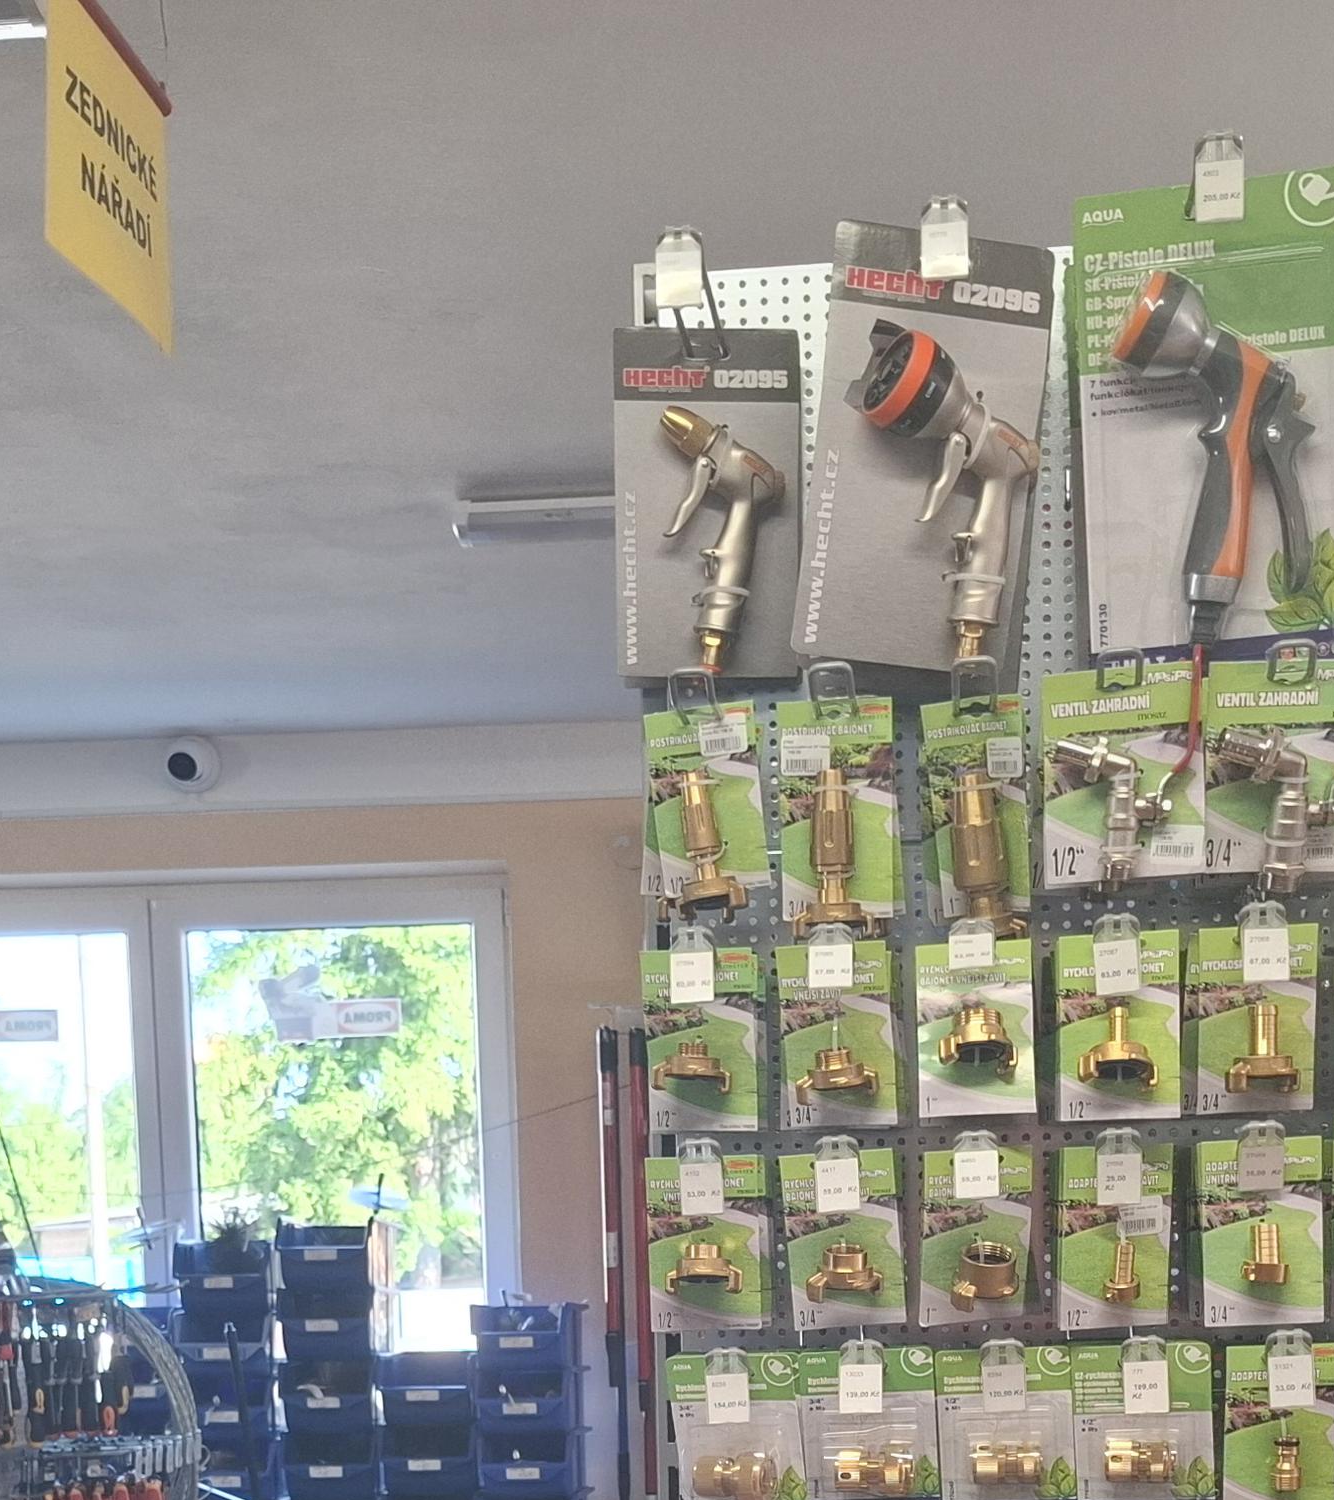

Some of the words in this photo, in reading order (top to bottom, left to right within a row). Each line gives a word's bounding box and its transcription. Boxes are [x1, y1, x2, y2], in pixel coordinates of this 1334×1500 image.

[65, 65, 158, 202] ZEDNICKÉ
[81, 152, 152, 258] NÁŘADÍ
[1081, 207, 1124, 227] AQUA
[1167, 238, 1216, 263] DELUX
[952, 280, 1041, 314] 02096
[713, 369, 788, 390] 02095
[804, 448, 841, 645] www.hecht.cz
[624, 490, 640, 666] www.hecht.cz
[1099, 603, 1108, 647] 770130
[1050, 701, 1090, 718] VENTIL
[1092, 693, 1152, 716] ZAHRADNÍ
[1216, 691, 1256, 708] VENTIL
[1258, 688, 1320, 707] ZAHRADNÍ
